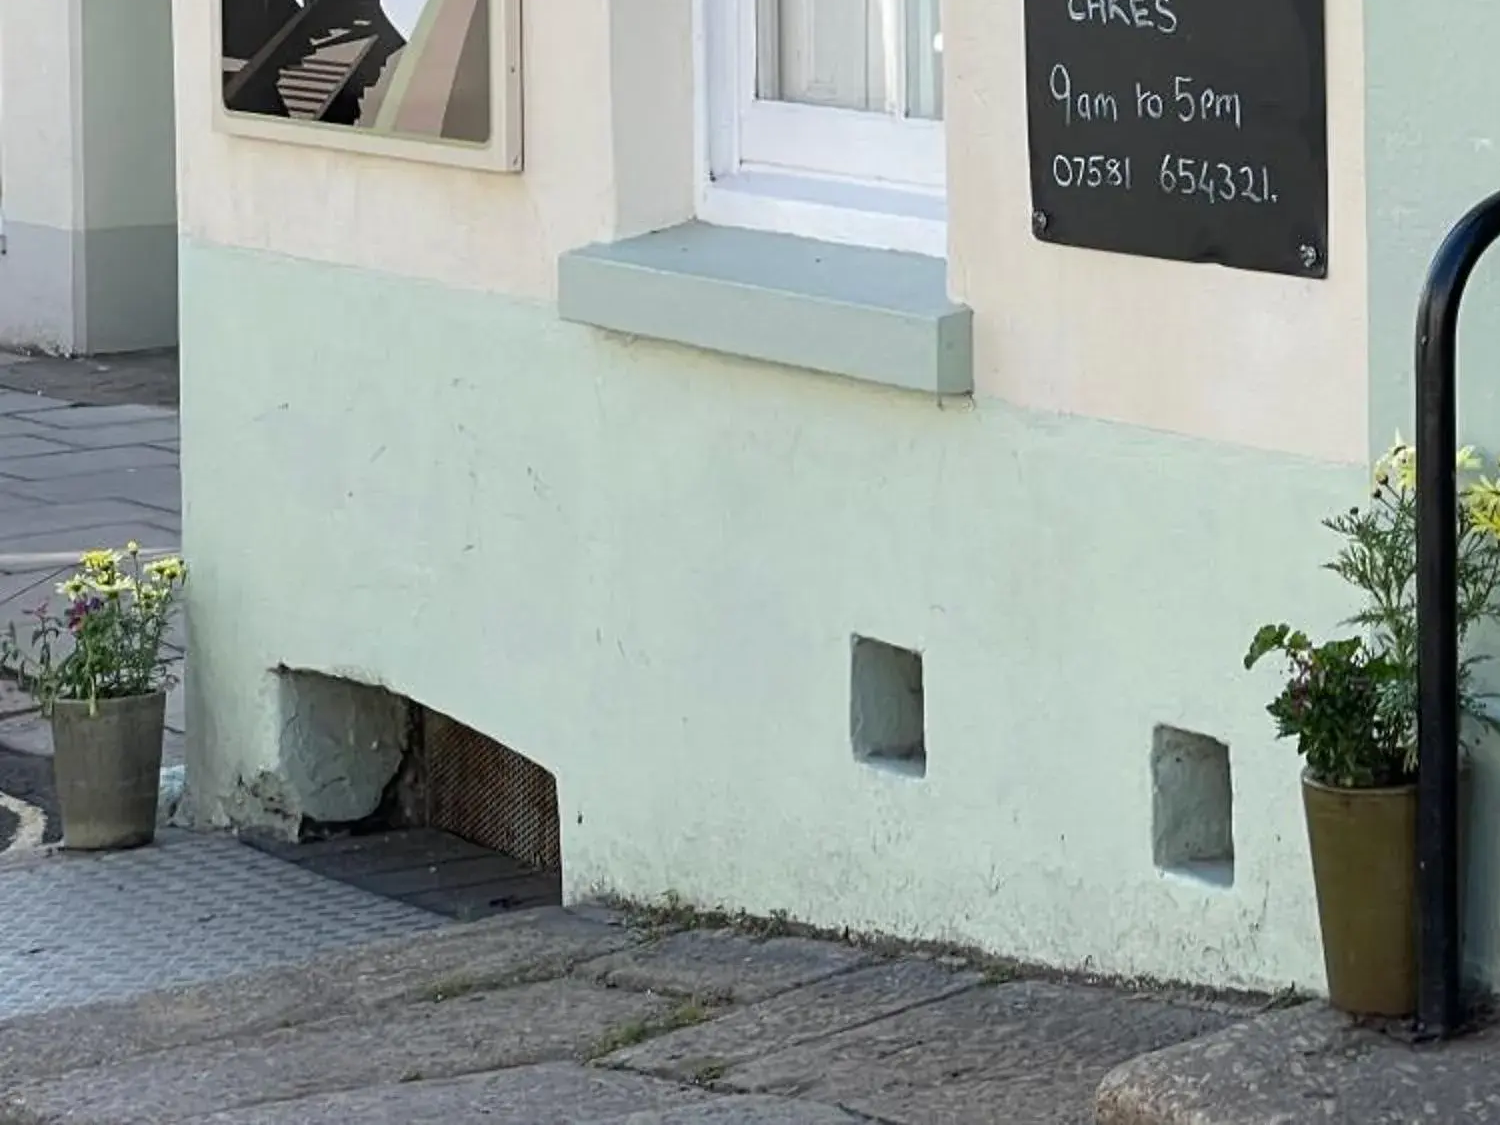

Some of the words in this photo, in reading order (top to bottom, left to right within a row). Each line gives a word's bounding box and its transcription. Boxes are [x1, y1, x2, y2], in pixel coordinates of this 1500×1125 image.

[1050, 63, 1118, 125] 9am
[1136, 82, 1163, 118] to
[1174, 76, 1241, 127] 5pm
[1053, 154, 1132, 189] 07581
